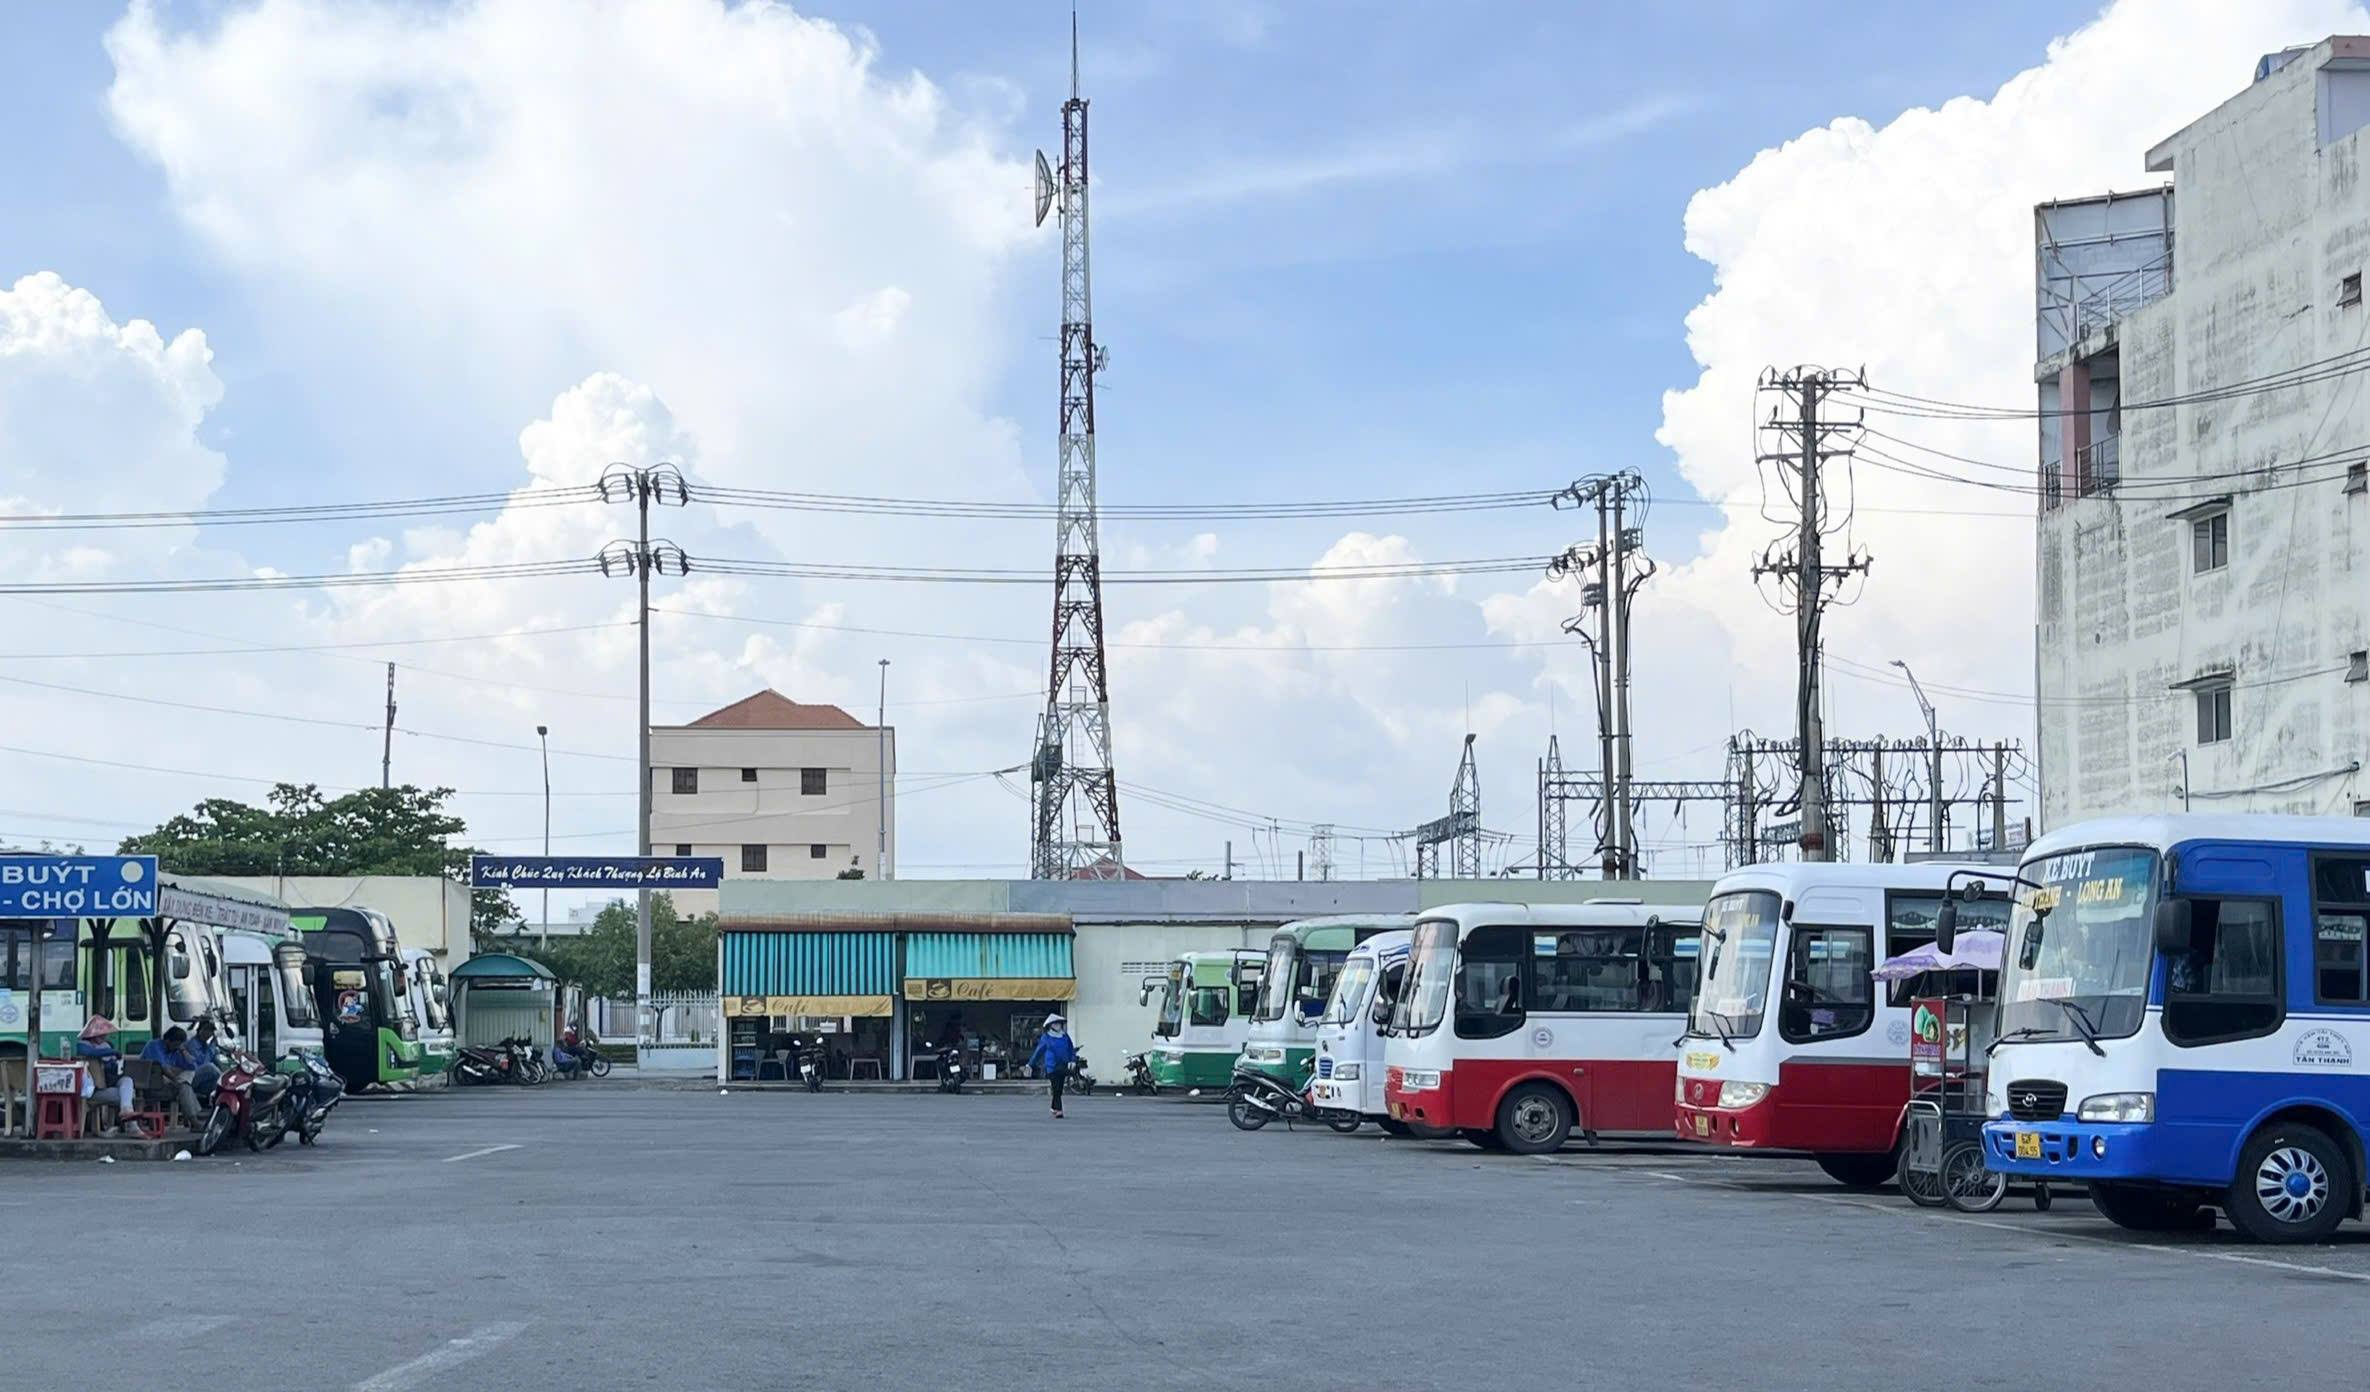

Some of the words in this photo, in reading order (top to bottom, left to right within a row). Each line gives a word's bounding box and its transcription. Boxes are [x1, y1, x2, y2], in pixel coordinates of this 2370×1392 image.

[2, 860, 96, 884] BUÝT
[689, 866, 707, 879] An
[2042, 857, 2061, 883] XE
[21, 888, 86, 913] CHỢ
[93, 886, 152, 910] LỚN
[2077, 879, 2106, 905] LONG
[2104, 877, 2124, 901] AN
[957, 983, 993, 999] Café
